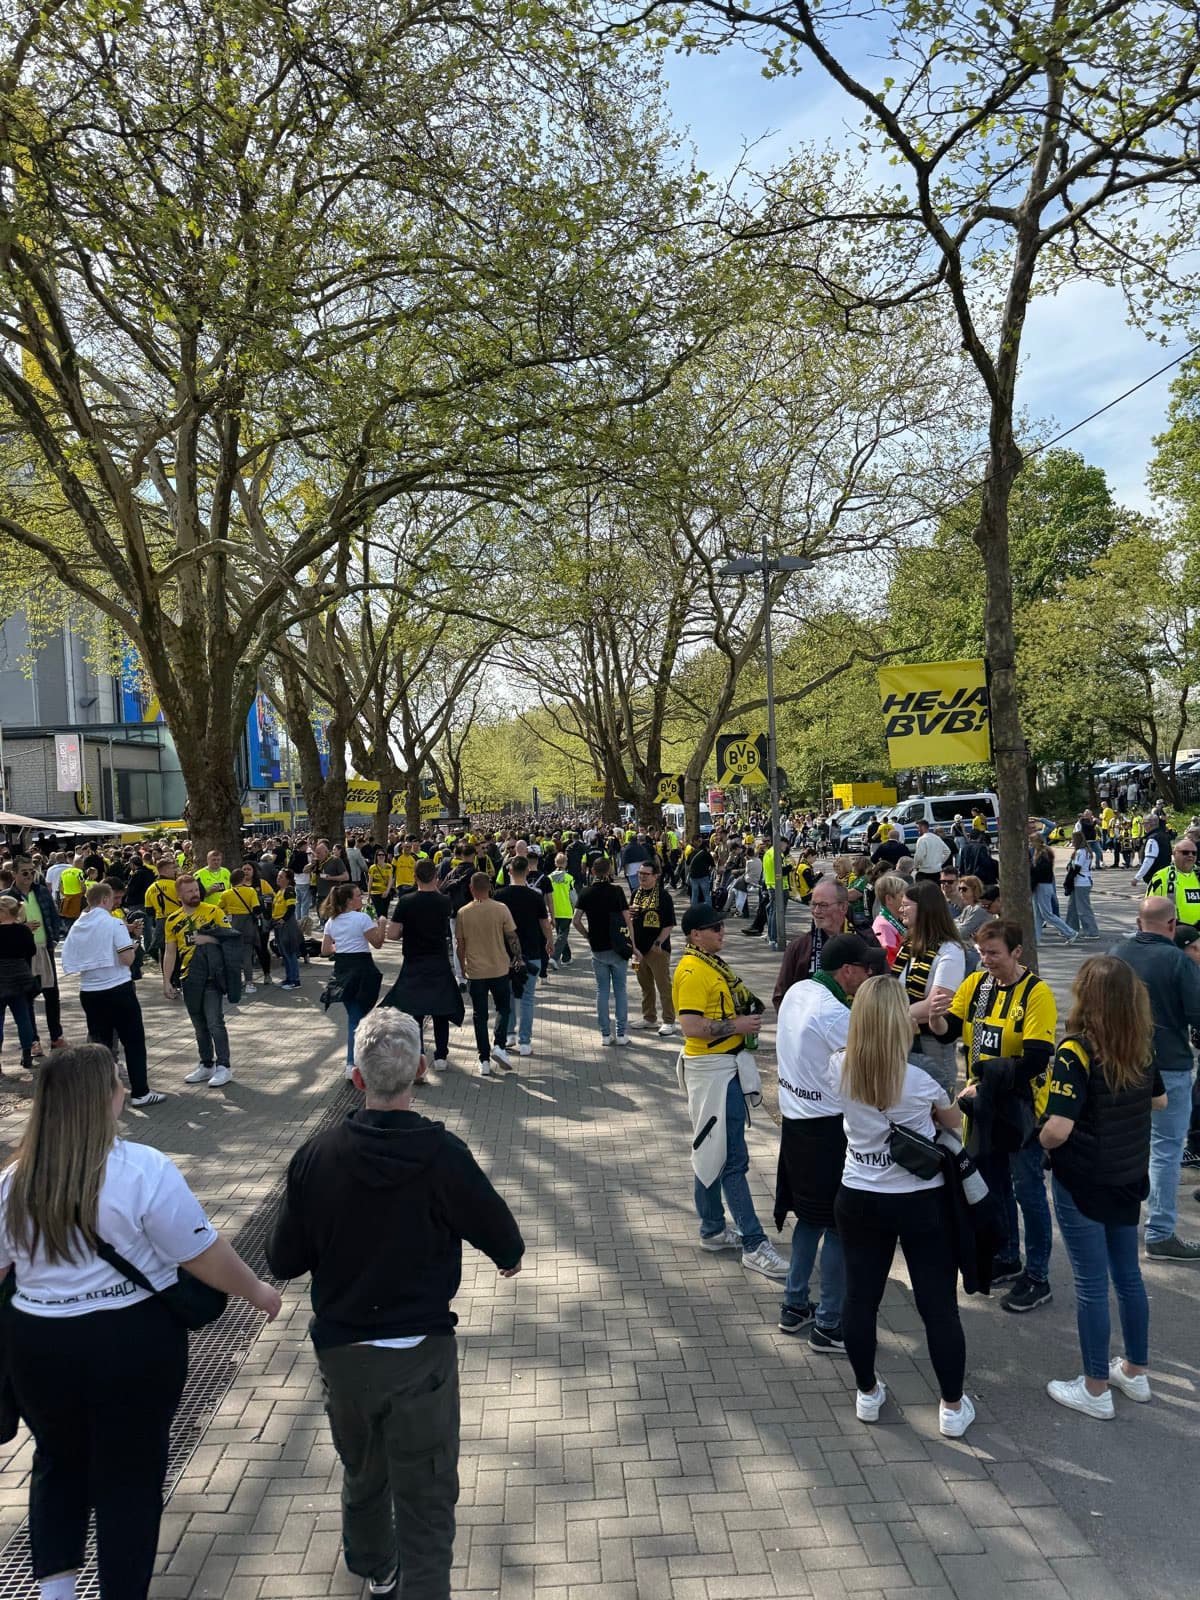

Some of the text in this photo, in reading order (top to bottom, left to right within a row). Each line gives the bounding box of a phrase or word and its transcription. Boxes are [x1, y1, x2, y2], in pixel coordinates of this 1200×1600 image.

[882, 686, 988, 714] HEJA
[885, 709, 989, 738] BVB!
[729, 743, 756, 765] BVB
[737, 764, 748, 772] 09
[660, 779, 677, 793] BVB
[980, 1030, 999, 1049] 1&1
